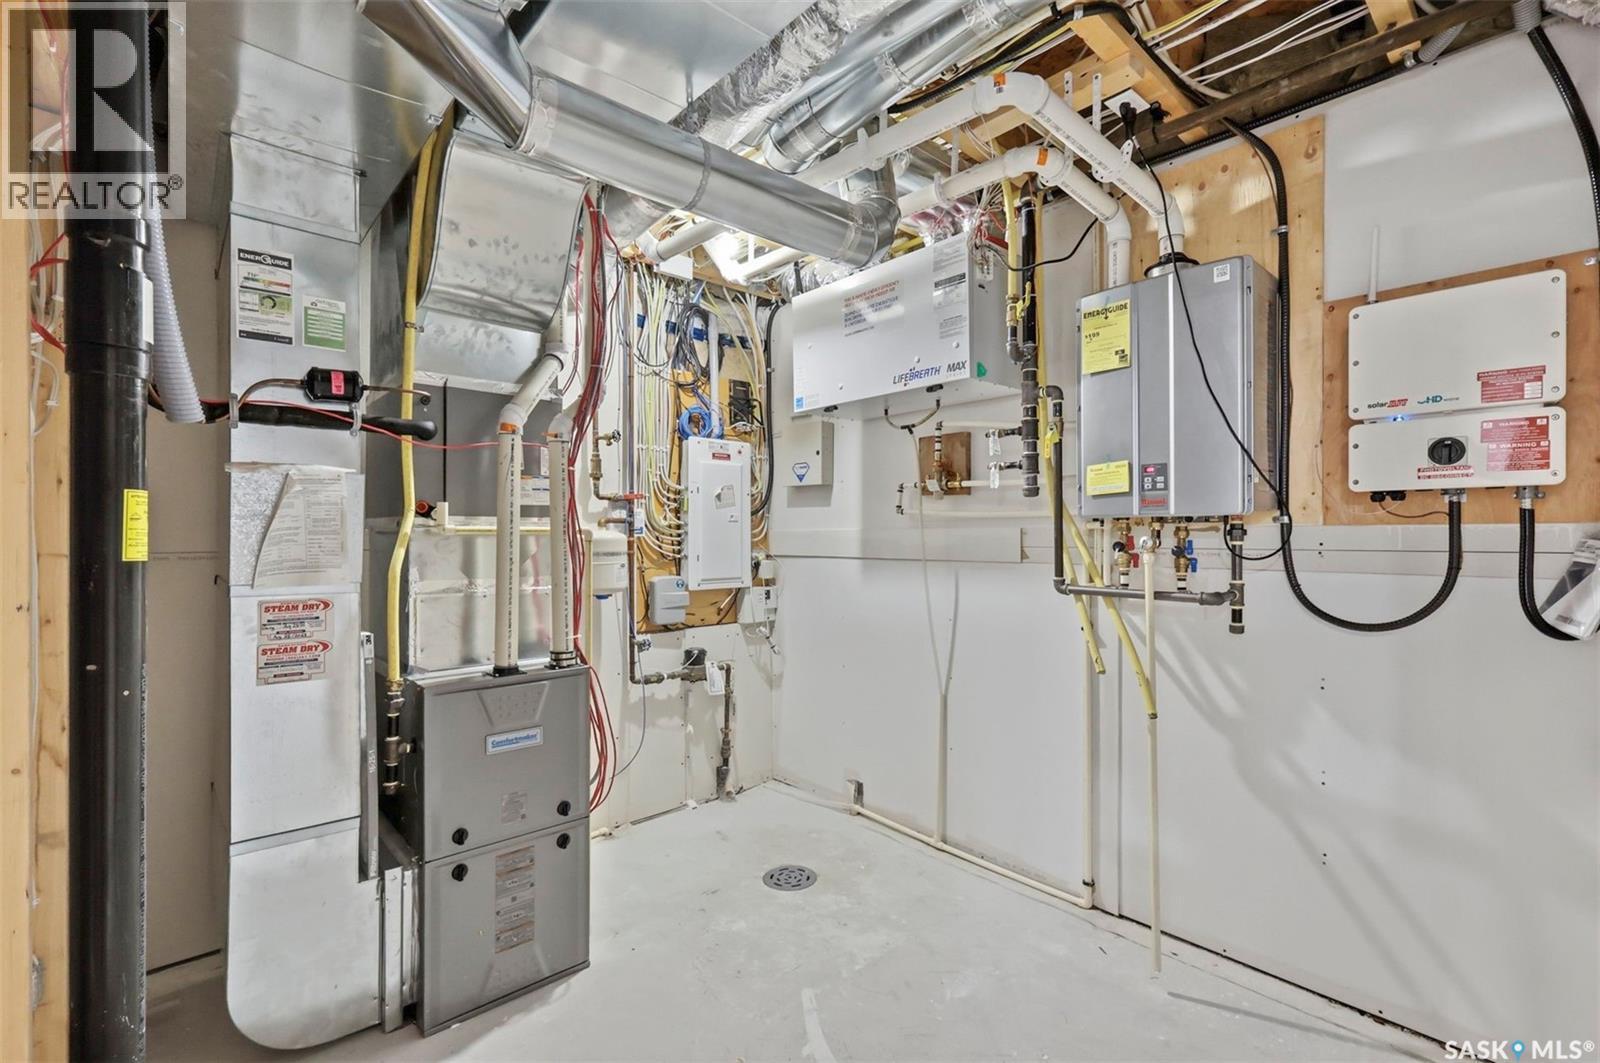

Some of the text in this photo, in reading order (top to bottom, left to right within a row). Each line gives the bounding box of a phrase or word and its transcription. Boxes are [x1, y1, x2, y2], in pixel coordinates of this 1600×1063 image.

[892, 360, 967, 385] LIFEBREATH MAX
[1499, 441, 1537, 449] WARNING
[263, 603, 321, 614] STEAM DRY
[261, 644, 320, 656] STEAM DRY
